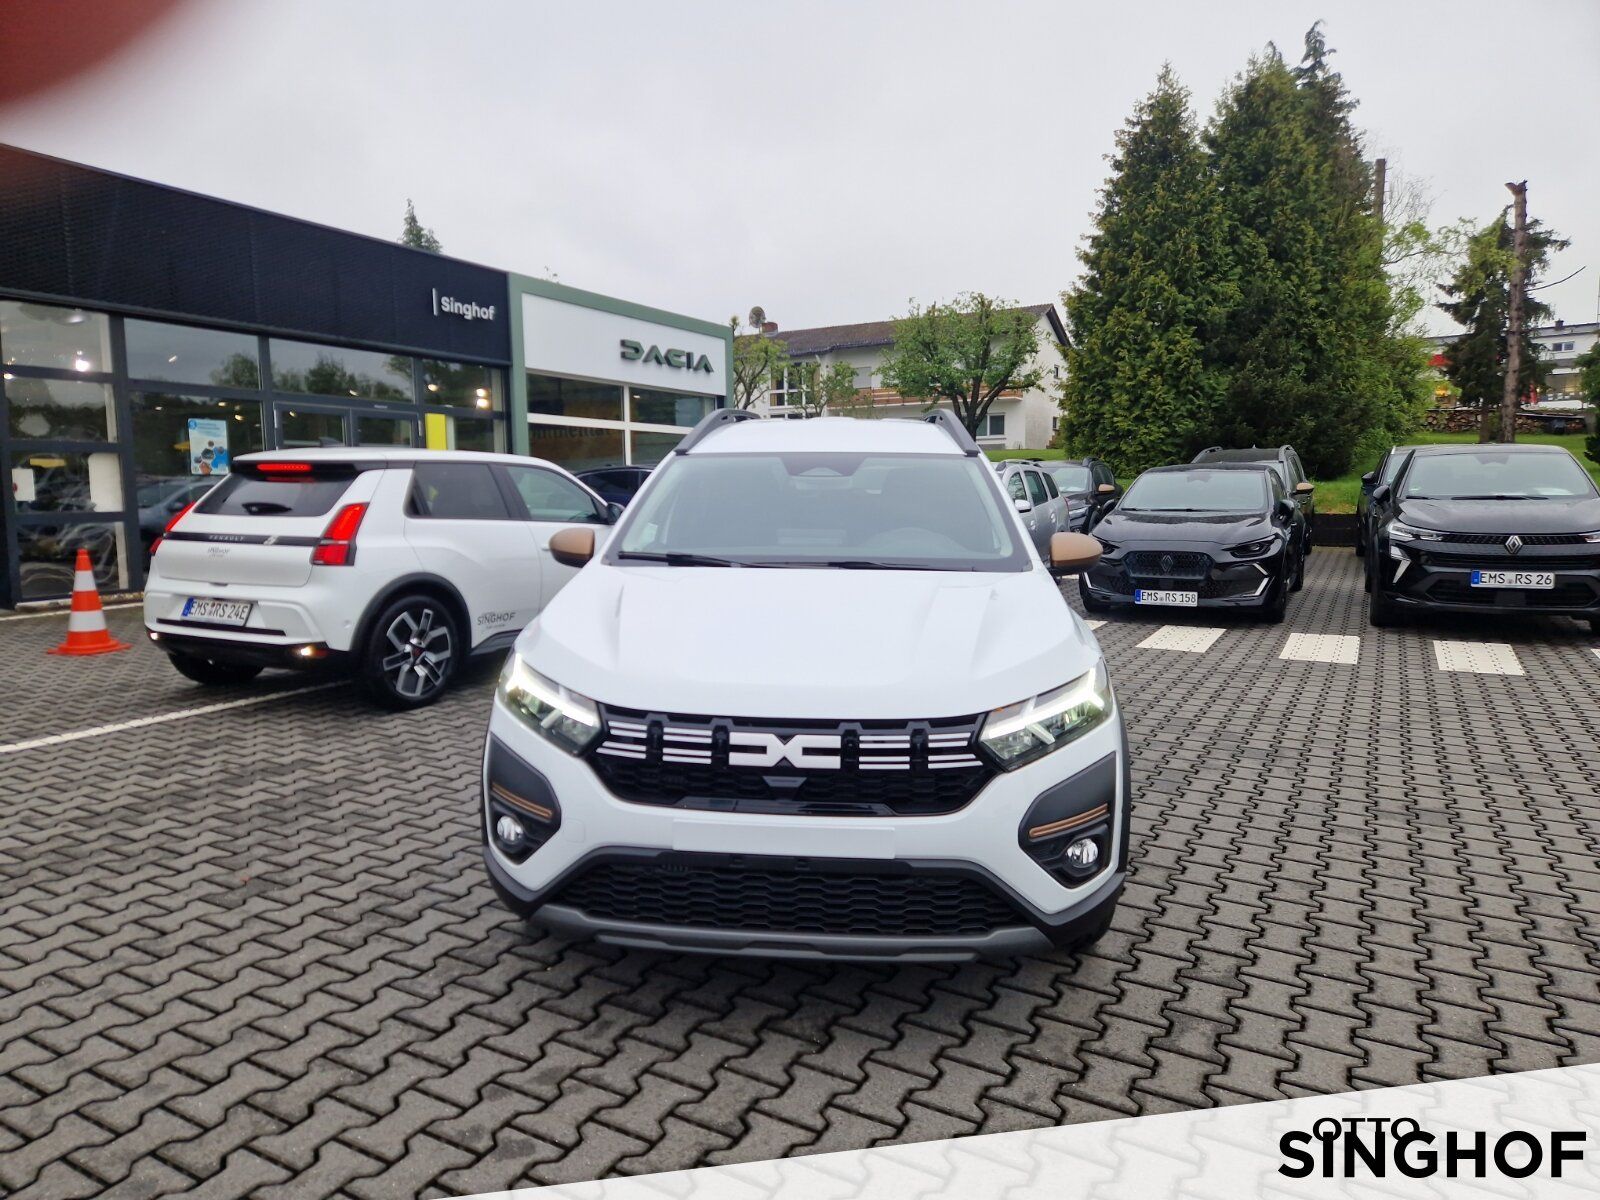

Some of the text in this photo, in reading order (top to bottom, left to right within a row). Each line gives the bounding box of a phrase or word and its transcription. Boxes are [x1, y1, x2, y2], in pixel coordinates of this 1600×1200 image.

[441, 296, 495, 320] Singhof
[620, 339, 714, 373] DACIA
[1480, 572, 1552, 585] EMS RS 26
[1141, 591, 1197, 604] EMS RS 158
[189, 600, 248, 620] EMS RS 24E
[477, 611, 516, 626] SINGHOF
